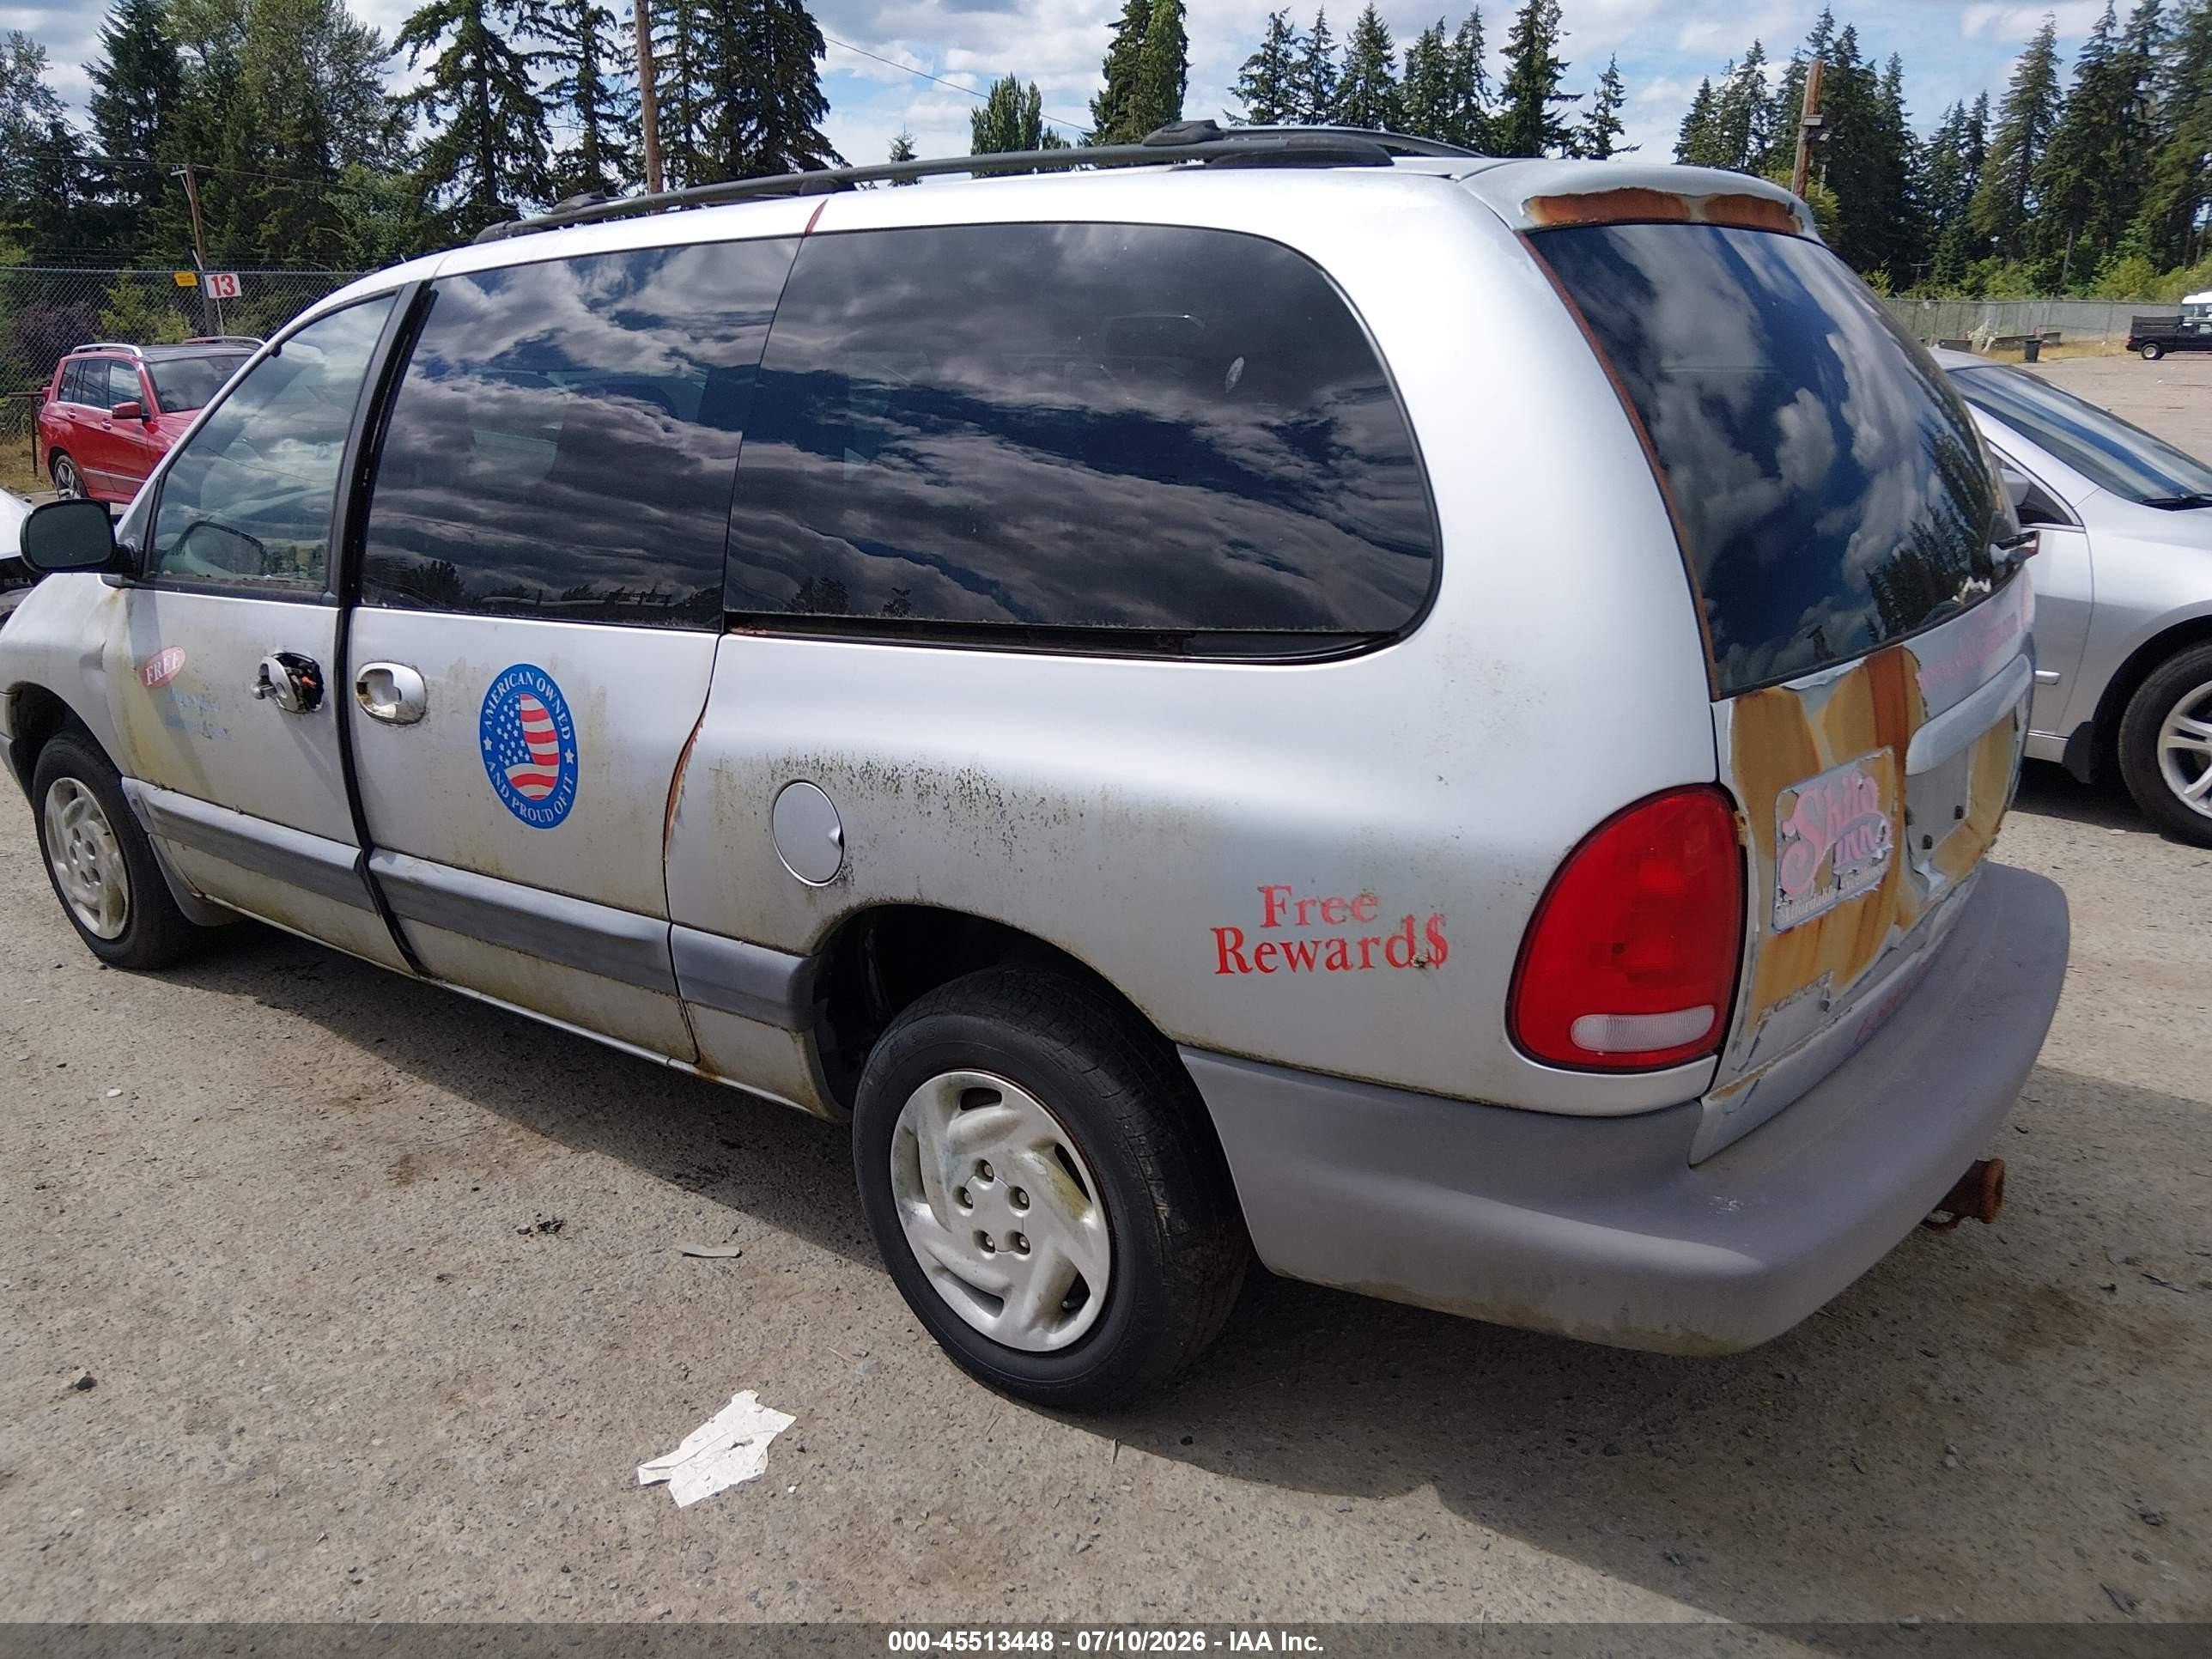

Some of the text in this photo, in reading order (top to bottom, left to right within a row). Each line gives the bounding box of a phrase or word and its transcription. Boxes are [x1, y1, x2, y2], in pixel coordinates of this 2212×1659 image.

[210, 274, 236, 297] 13
[145, 650, 182, 686] FREE
[483, 671, 571, 740] AMERICAN OWNED
[487, 761, 574, 823] AND PROUD OF IT
[1256, 884, 1380, 928] Free
[1209, 912, 1449, 975] Reward$
